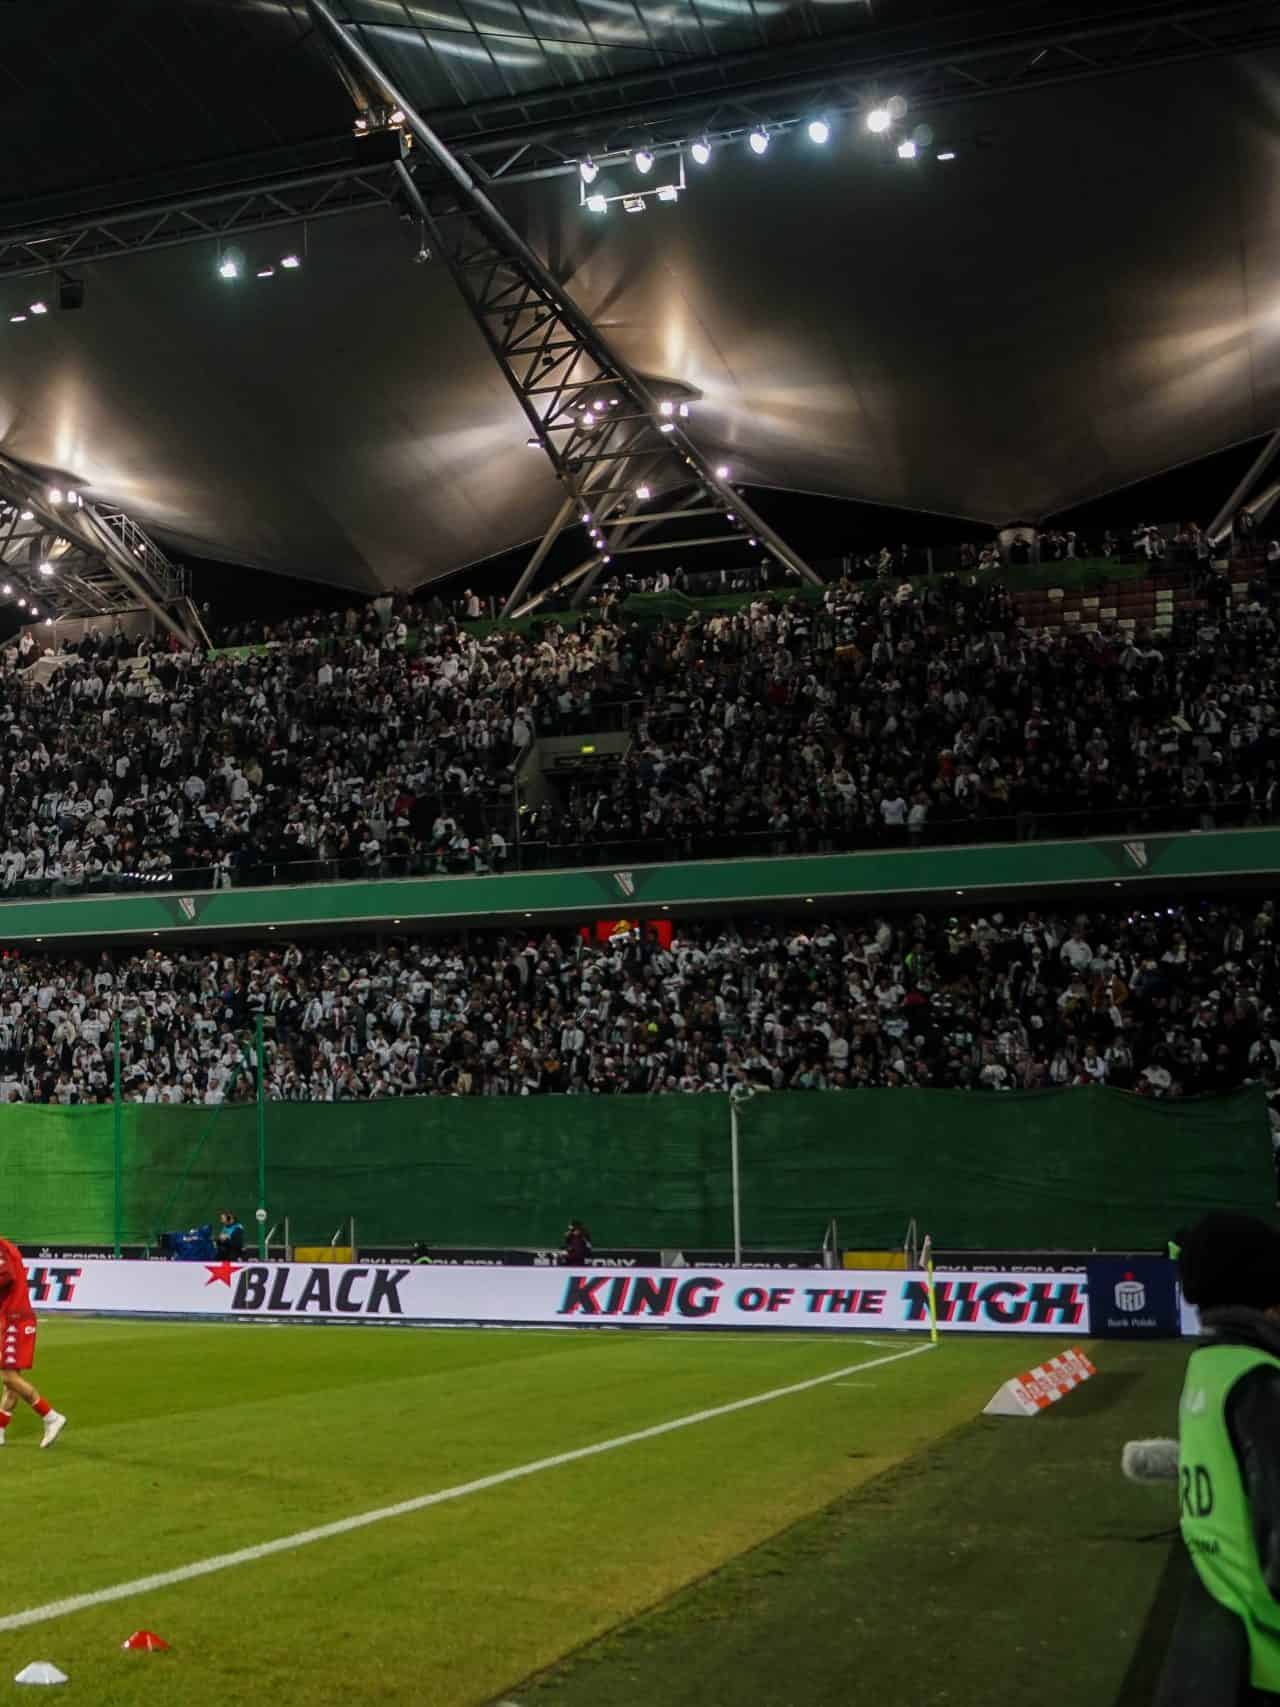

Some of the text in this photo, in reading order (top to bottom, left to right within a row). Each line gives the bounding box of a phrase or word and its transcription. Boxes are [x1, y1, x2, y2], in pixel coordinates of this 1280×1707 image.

[231, 1266, 410, 1315] BLACK
[555, 1276, 1089, 1325] KING OF THE NIGH
